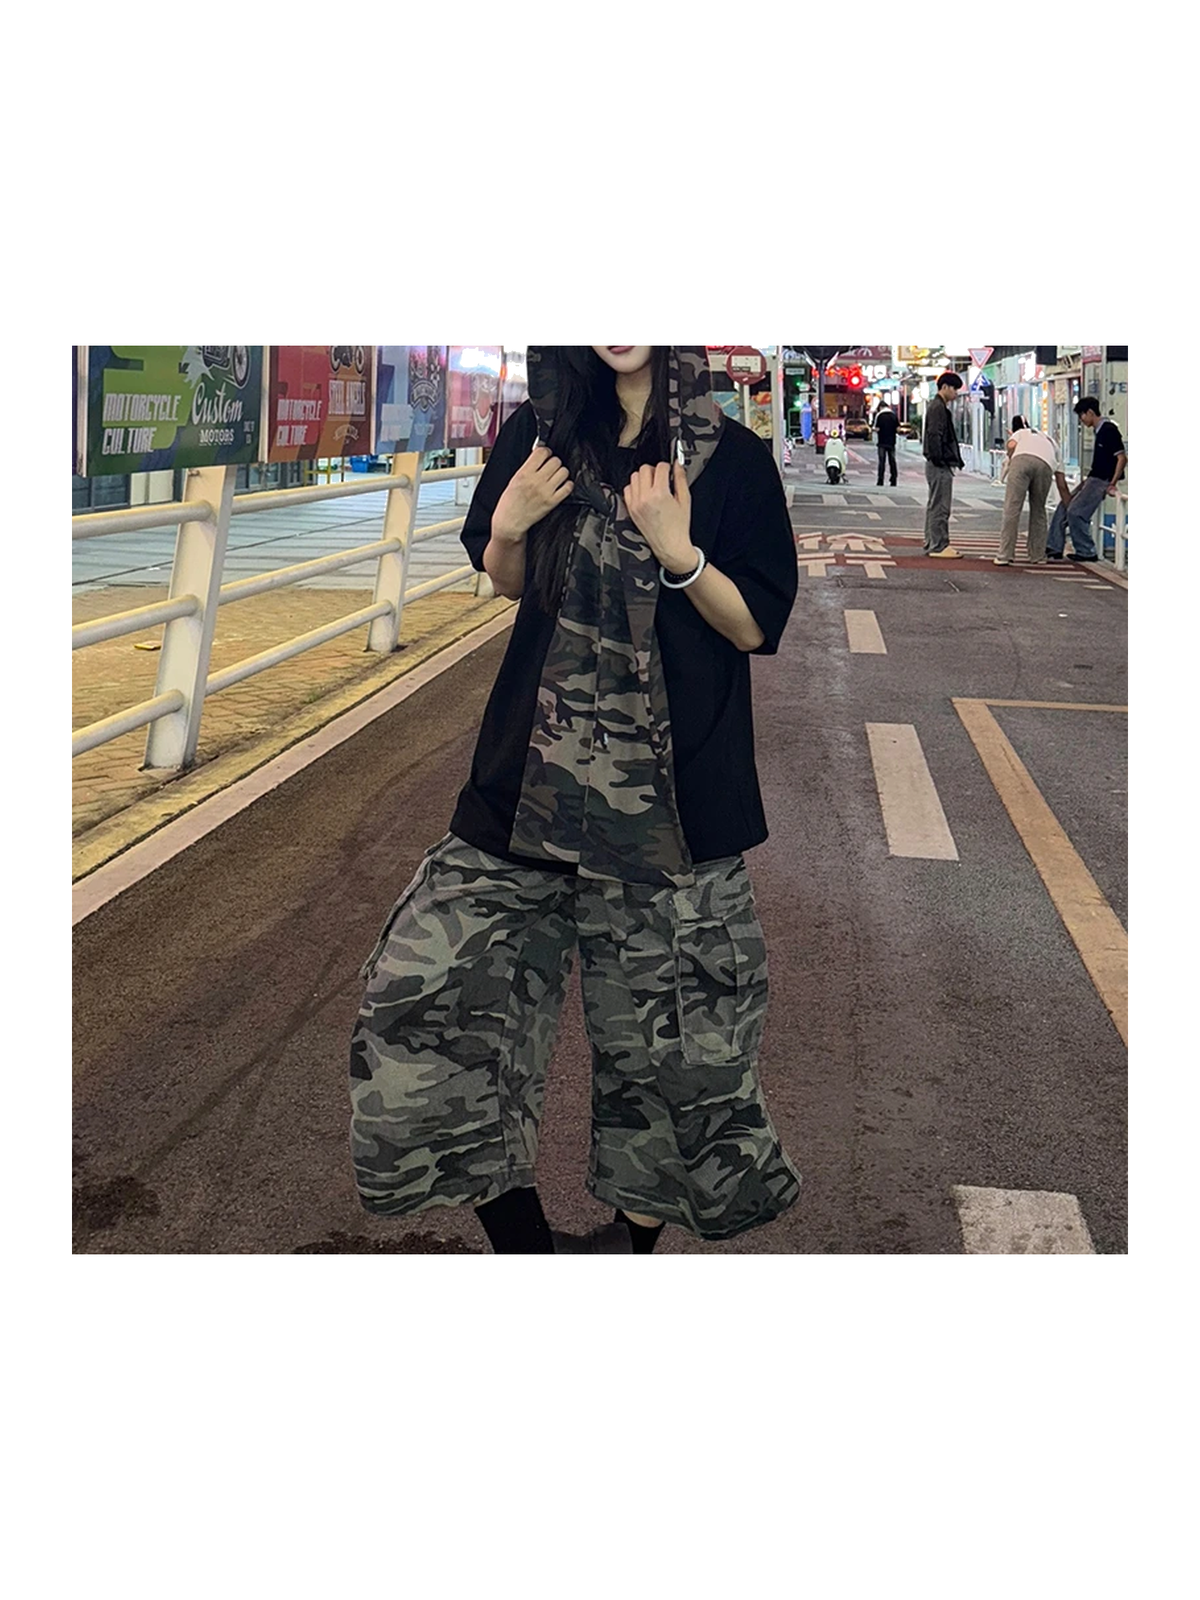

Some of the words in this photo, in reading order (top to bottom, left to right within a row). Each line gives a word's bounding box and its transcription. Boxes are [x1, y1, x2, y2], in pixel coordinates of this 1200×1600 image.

[102, 393, 181, 422] MOTORCYCLE
[102, 427, 157, 455] CULTURE
[199, 428, 235, 444] MOTORS
